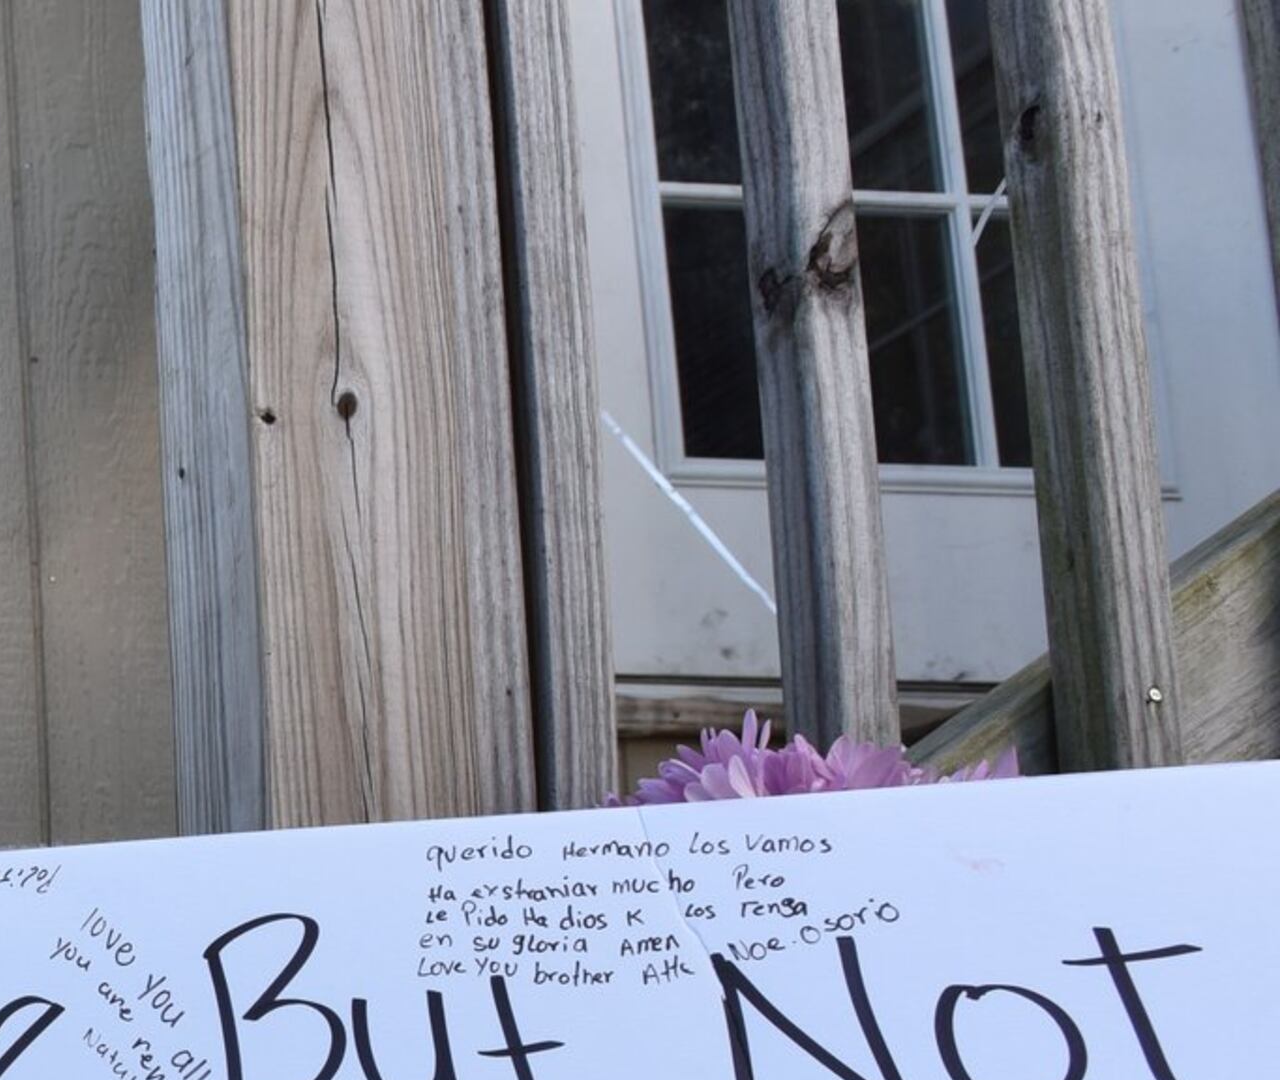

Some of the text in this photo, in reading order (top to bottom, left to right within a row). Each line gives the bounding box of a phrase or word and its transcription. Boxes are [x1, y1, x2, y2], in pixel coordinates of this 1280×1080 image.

[426, 831, 833, 873] querido Hermano Los Vamos
[731, 863, 786, 890] Pero
[460, 899, 509, 928] Pido
[558, 903, 609, 932] dios
[418, 933, 453, 950] en
[472, 935, 501, 953] su
[511, 933, 588, 956] gloria
[79, 907, 136, 968] love
[136, 973, 186, 1029] you
[416, 956, 467, 978] Love
[532, 959, 615, 988] brother
[97, 981, 134, 1023] are
